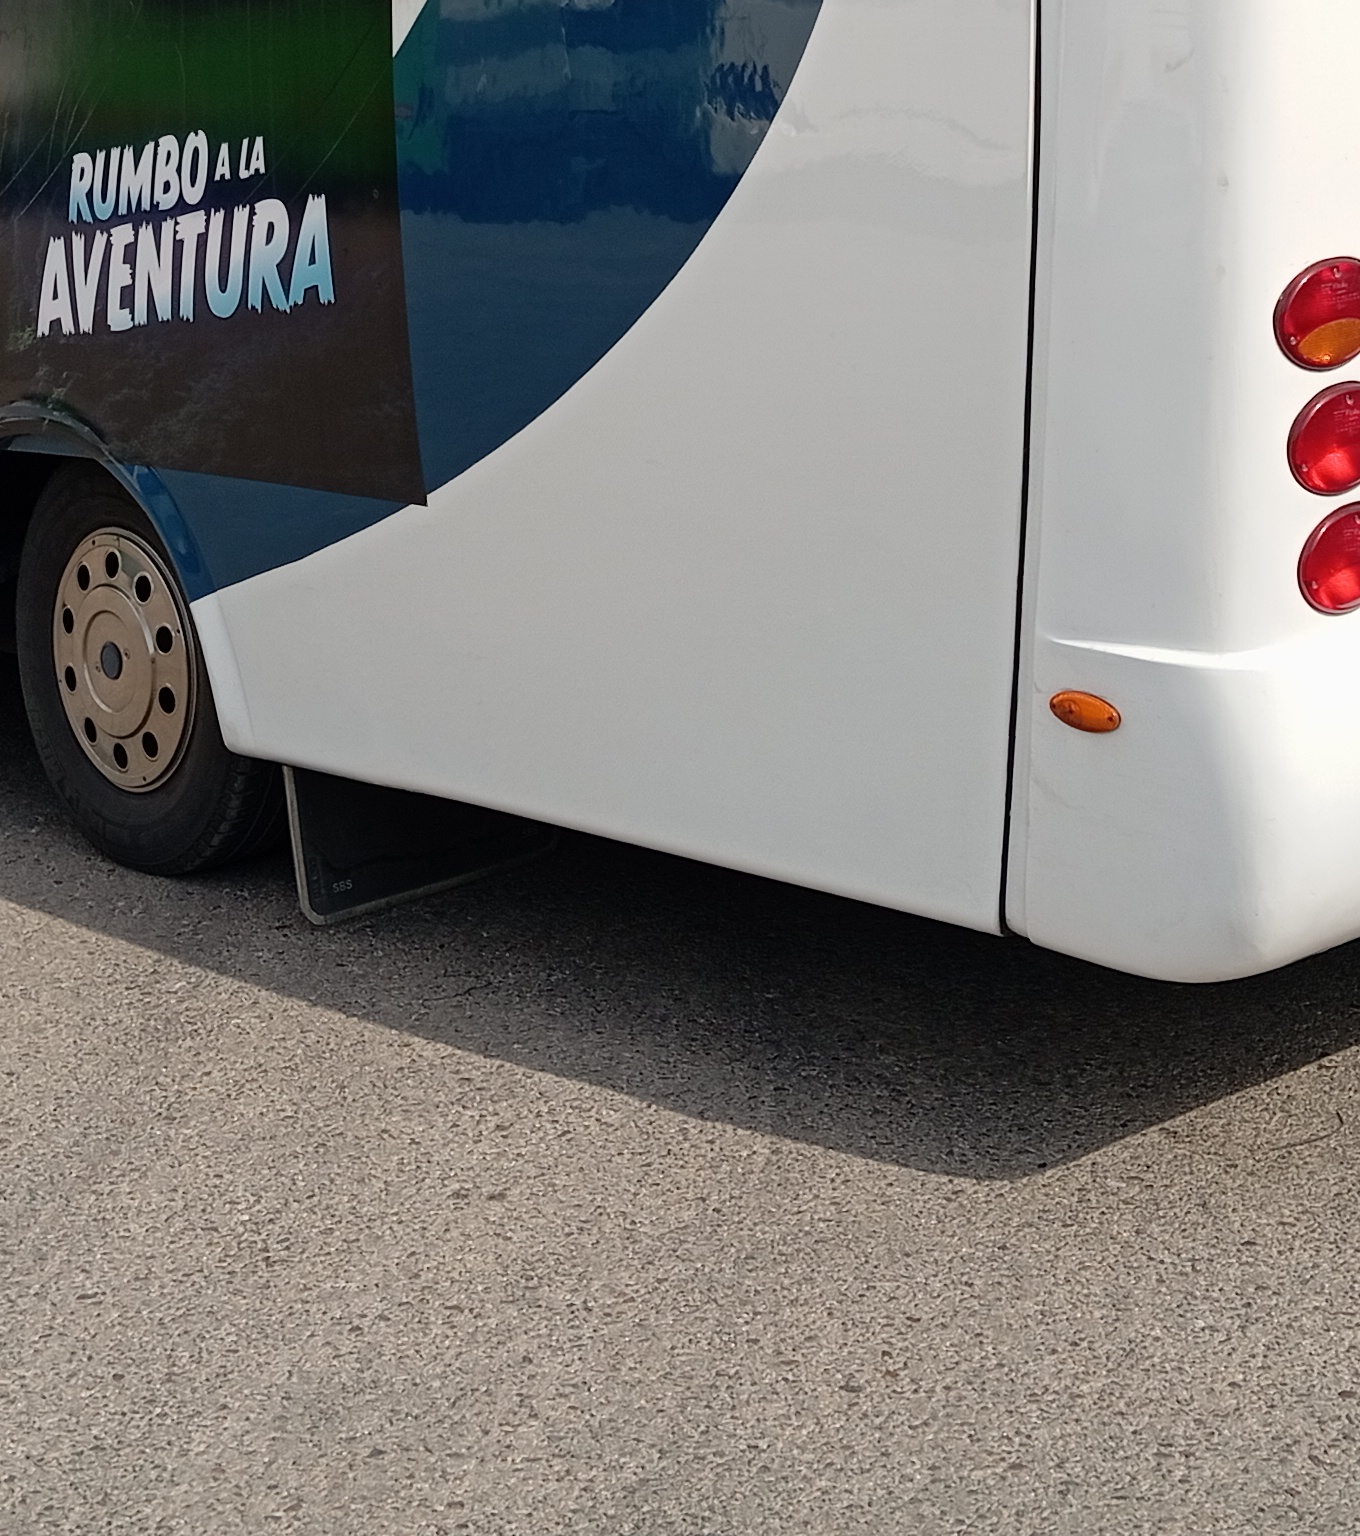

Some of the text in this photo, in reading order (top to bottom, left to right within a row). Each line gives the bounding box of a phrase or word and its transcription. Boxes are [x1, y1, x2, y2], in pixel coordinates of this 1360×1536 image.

[68, 129, 266, 224] RUMBO A LA
[36, 193, 335, 337] AVENTURA
